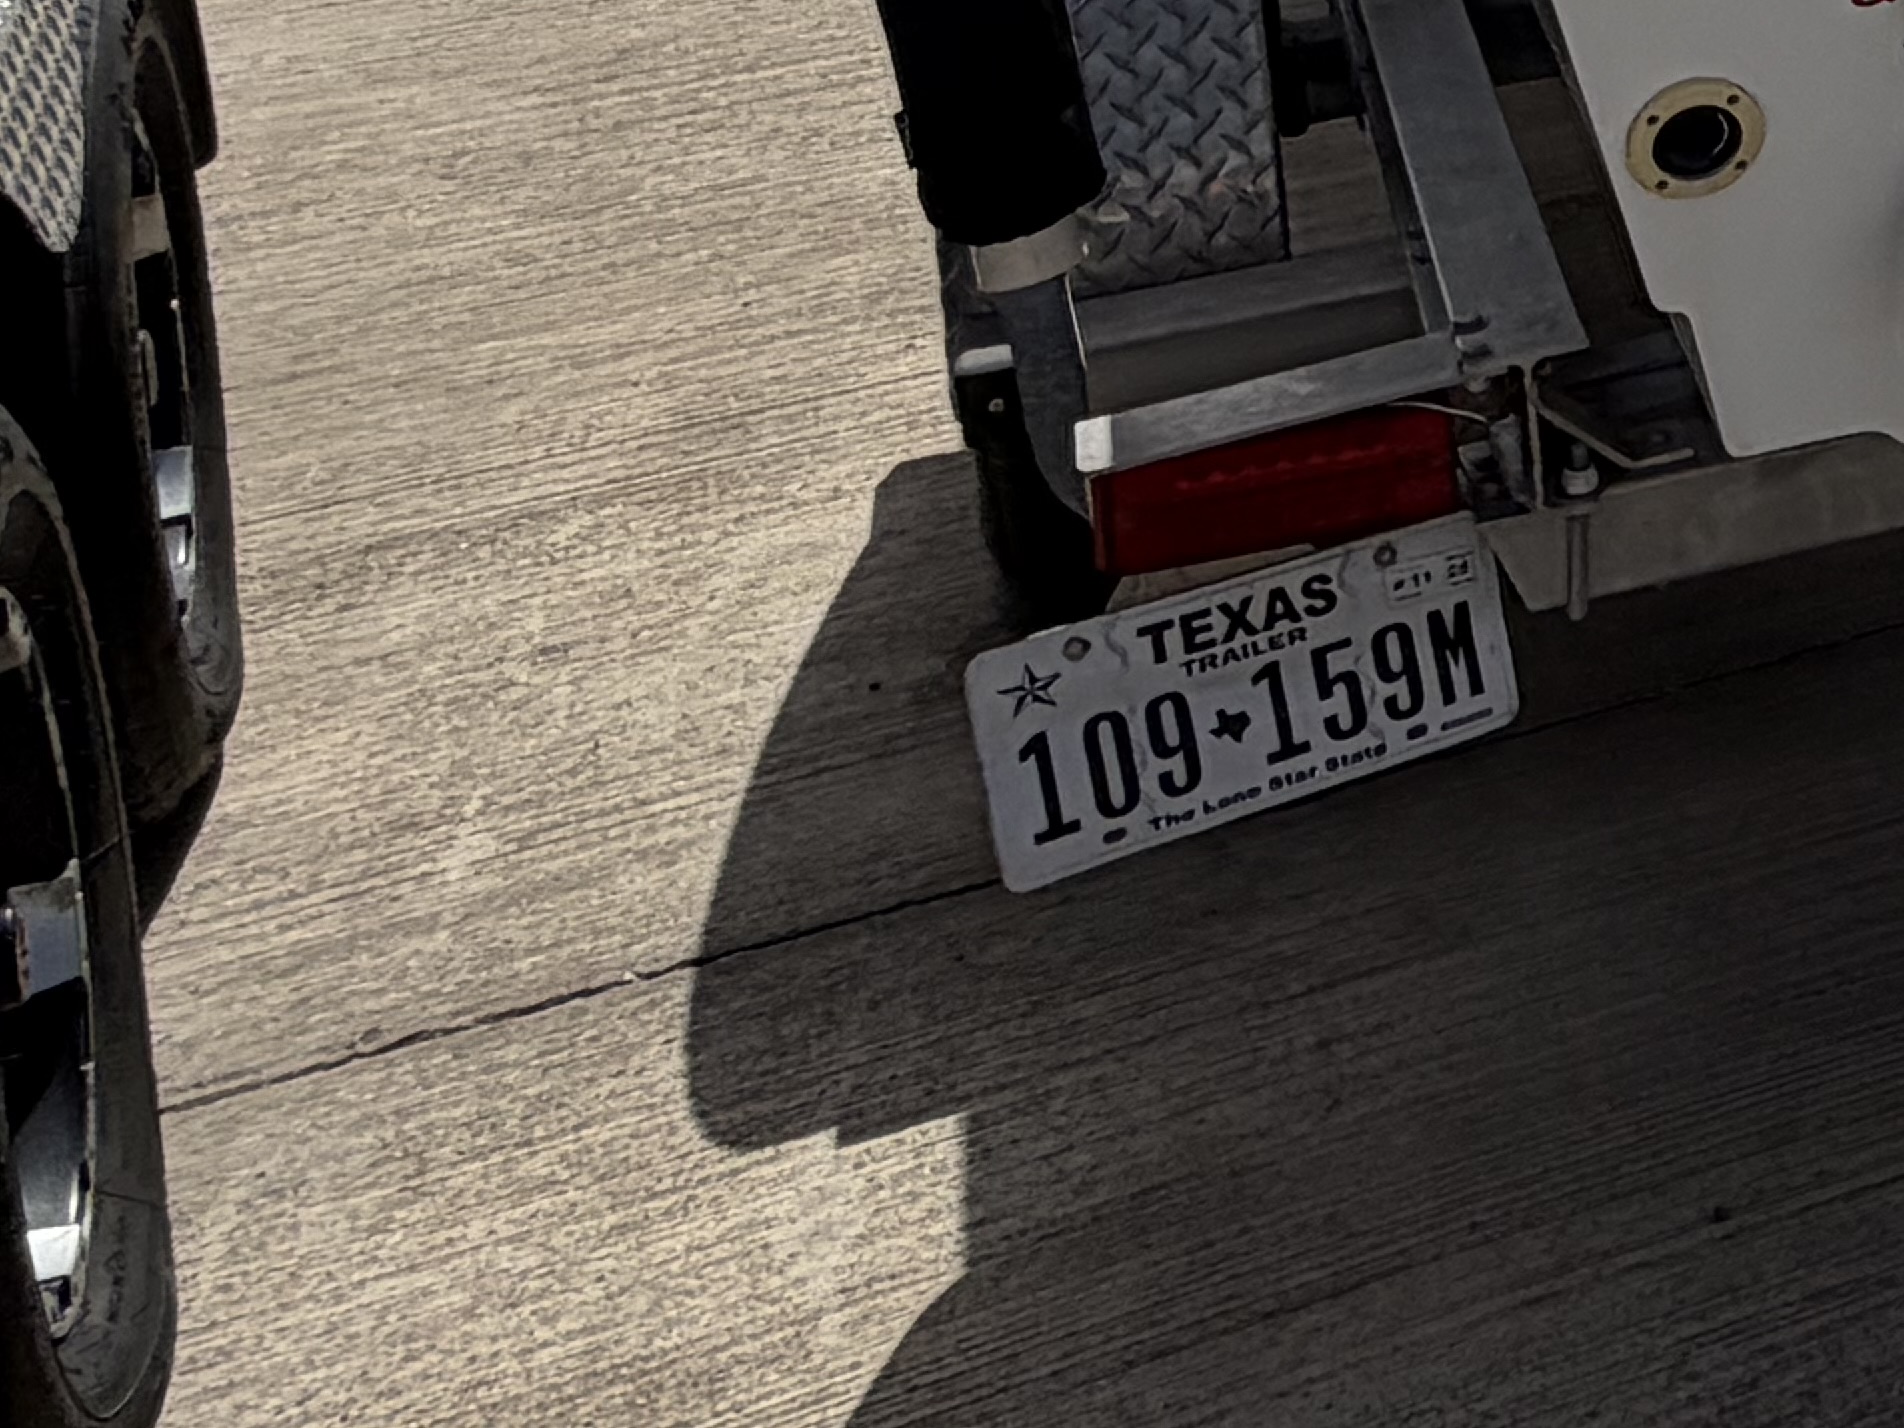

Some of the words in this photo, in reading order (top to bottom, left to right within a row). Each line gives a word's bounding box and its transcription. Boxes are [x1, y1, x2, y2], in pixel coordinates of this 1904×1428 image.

[1136, 573, 1339, 665] TEXAS
[1179, 626, 1308, 678] TRAILER
[1018, 690, 1203, 846] 109
[1250, 599, 1486, 766] 159M
[1148, 808, 1196, 832] The
[1202, 785, 1262, 815] Lone
[1268, 765, 1319, 792] Star
[1324, 742, 1388, 773] State
